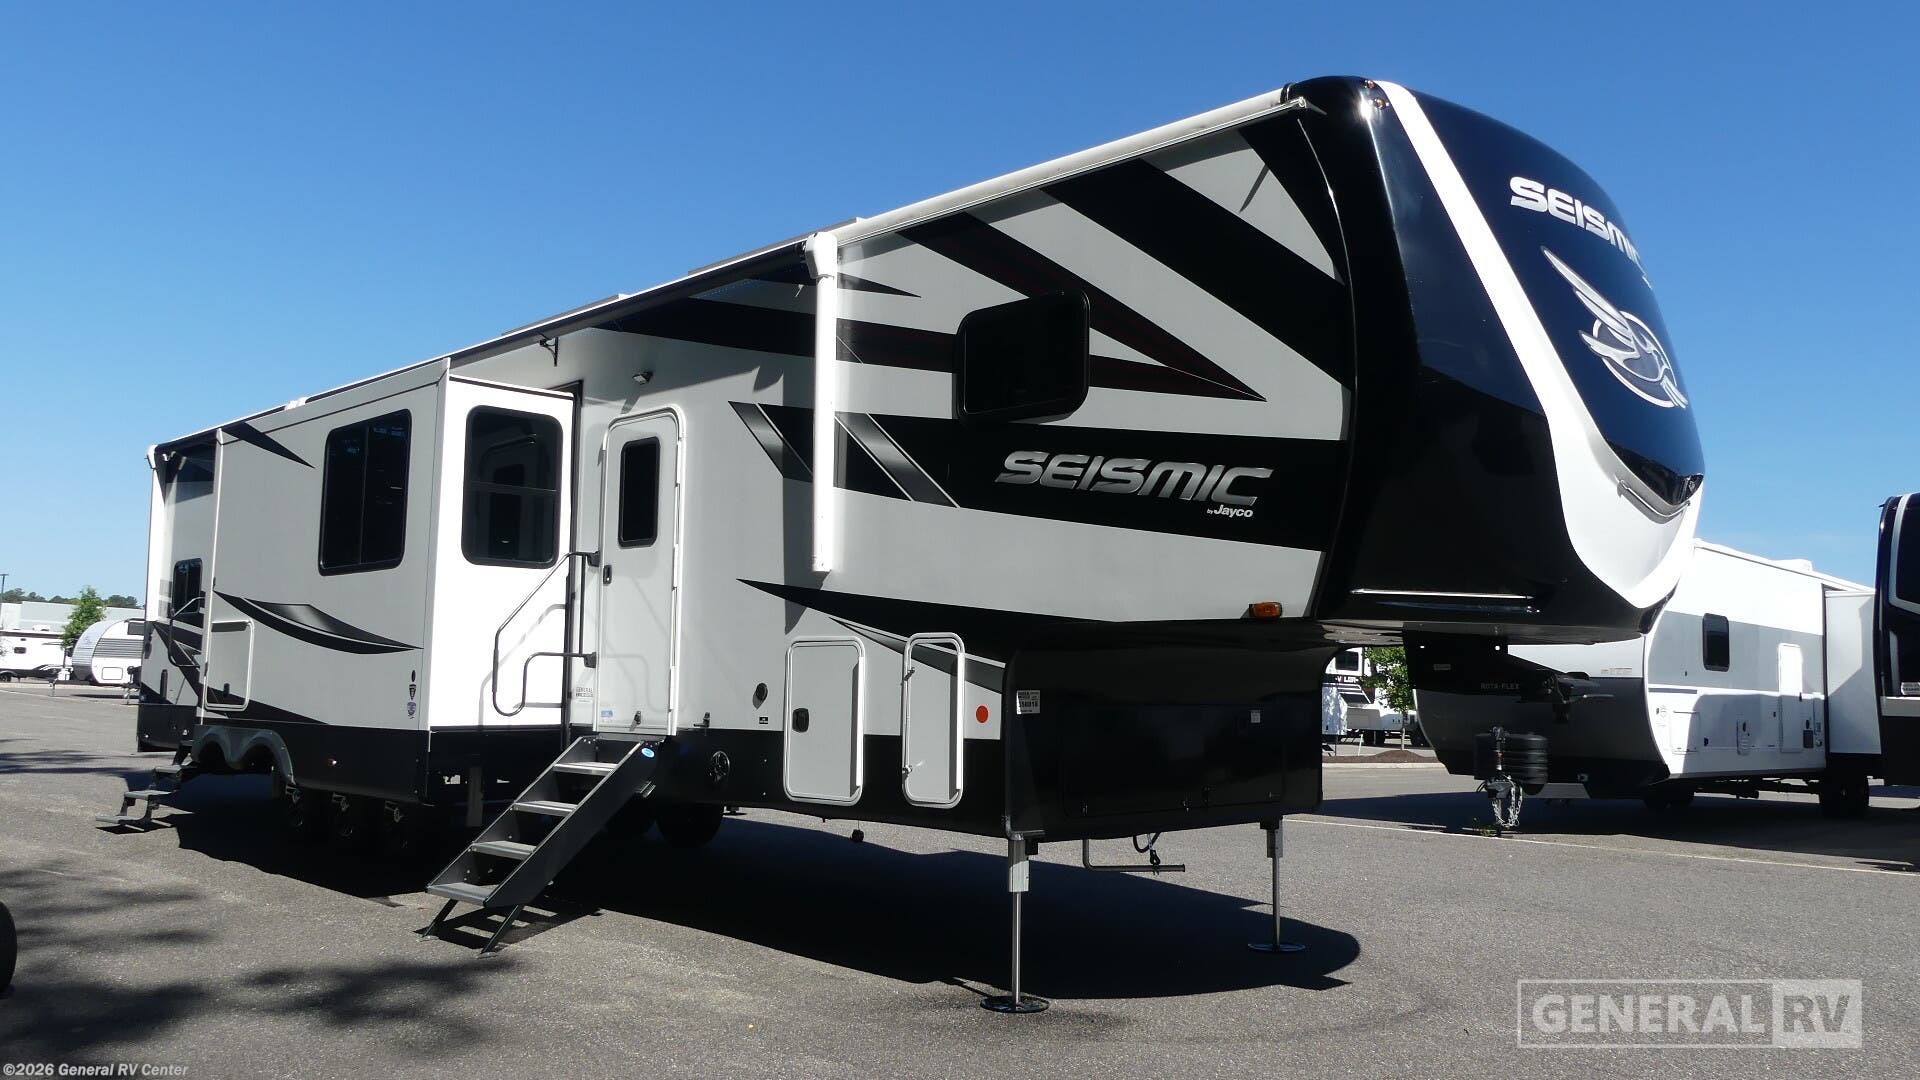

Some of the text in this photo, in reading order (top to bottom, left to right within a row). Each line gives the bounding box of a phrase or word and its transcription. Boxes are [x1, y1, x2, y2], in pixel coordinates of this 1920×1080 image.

[1509, 176, 1651, 288] SEISMI
[995, 451, 1274, 506] SEISMIC
[1213, 504, 1253, 518] Jayco
